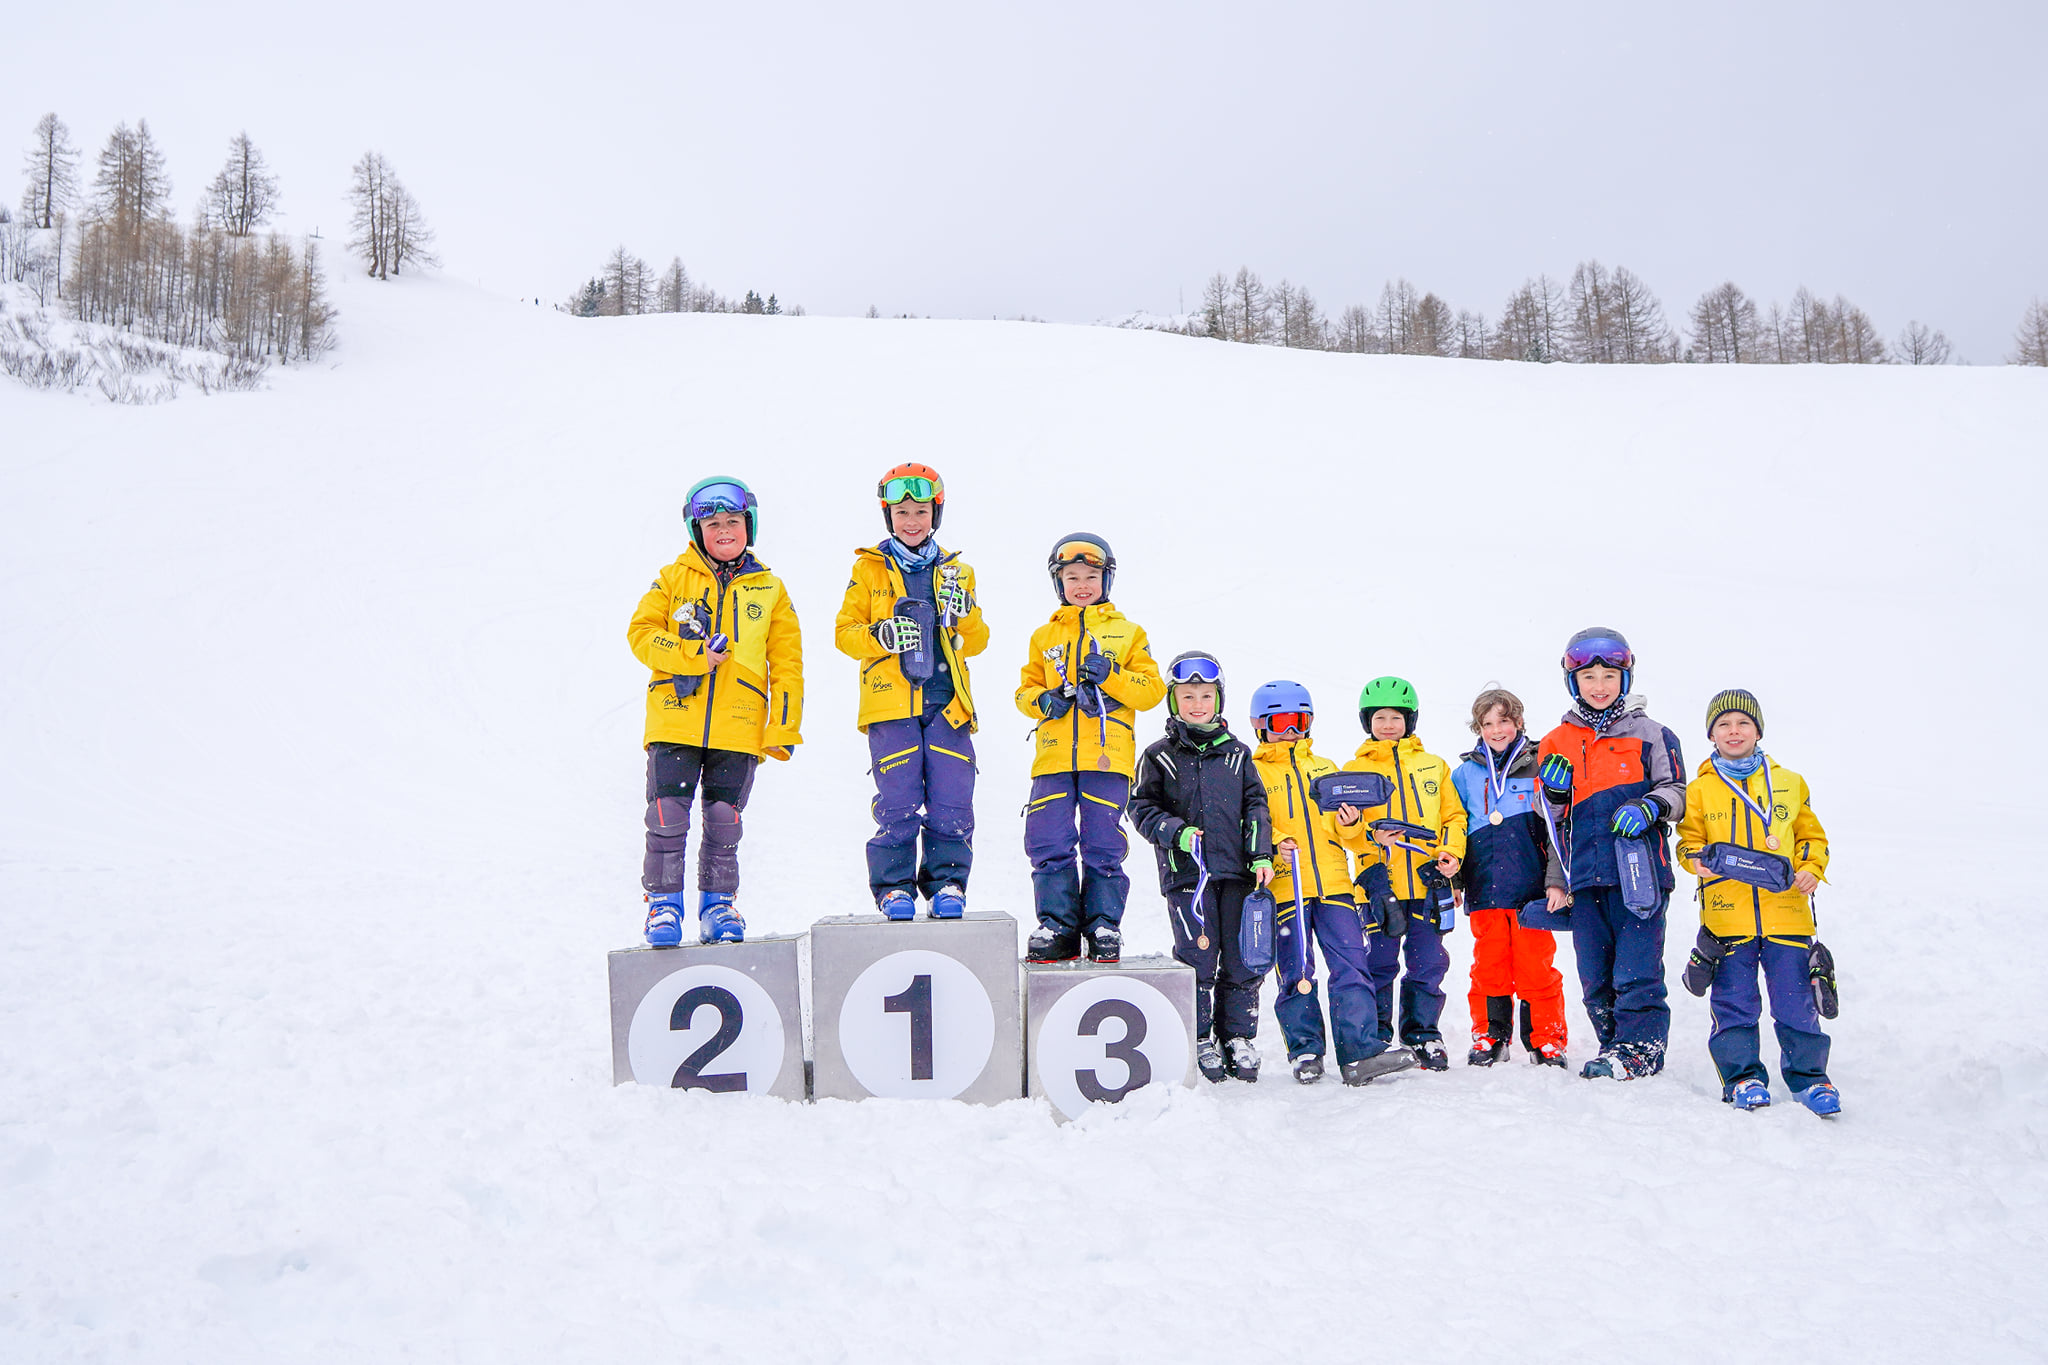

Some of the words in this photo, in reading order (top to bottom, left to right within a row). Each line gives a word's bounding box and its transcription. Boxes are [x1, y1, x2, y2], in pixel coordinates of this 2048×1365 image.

[1131, 676, 1147, 687] AAC
[1267, 785, 1284, 795] BPI
[670, 985, 748, 1094] 2
[884, 974, 934, 1081] 1
[1074, 998, 1152, 1104] 3
